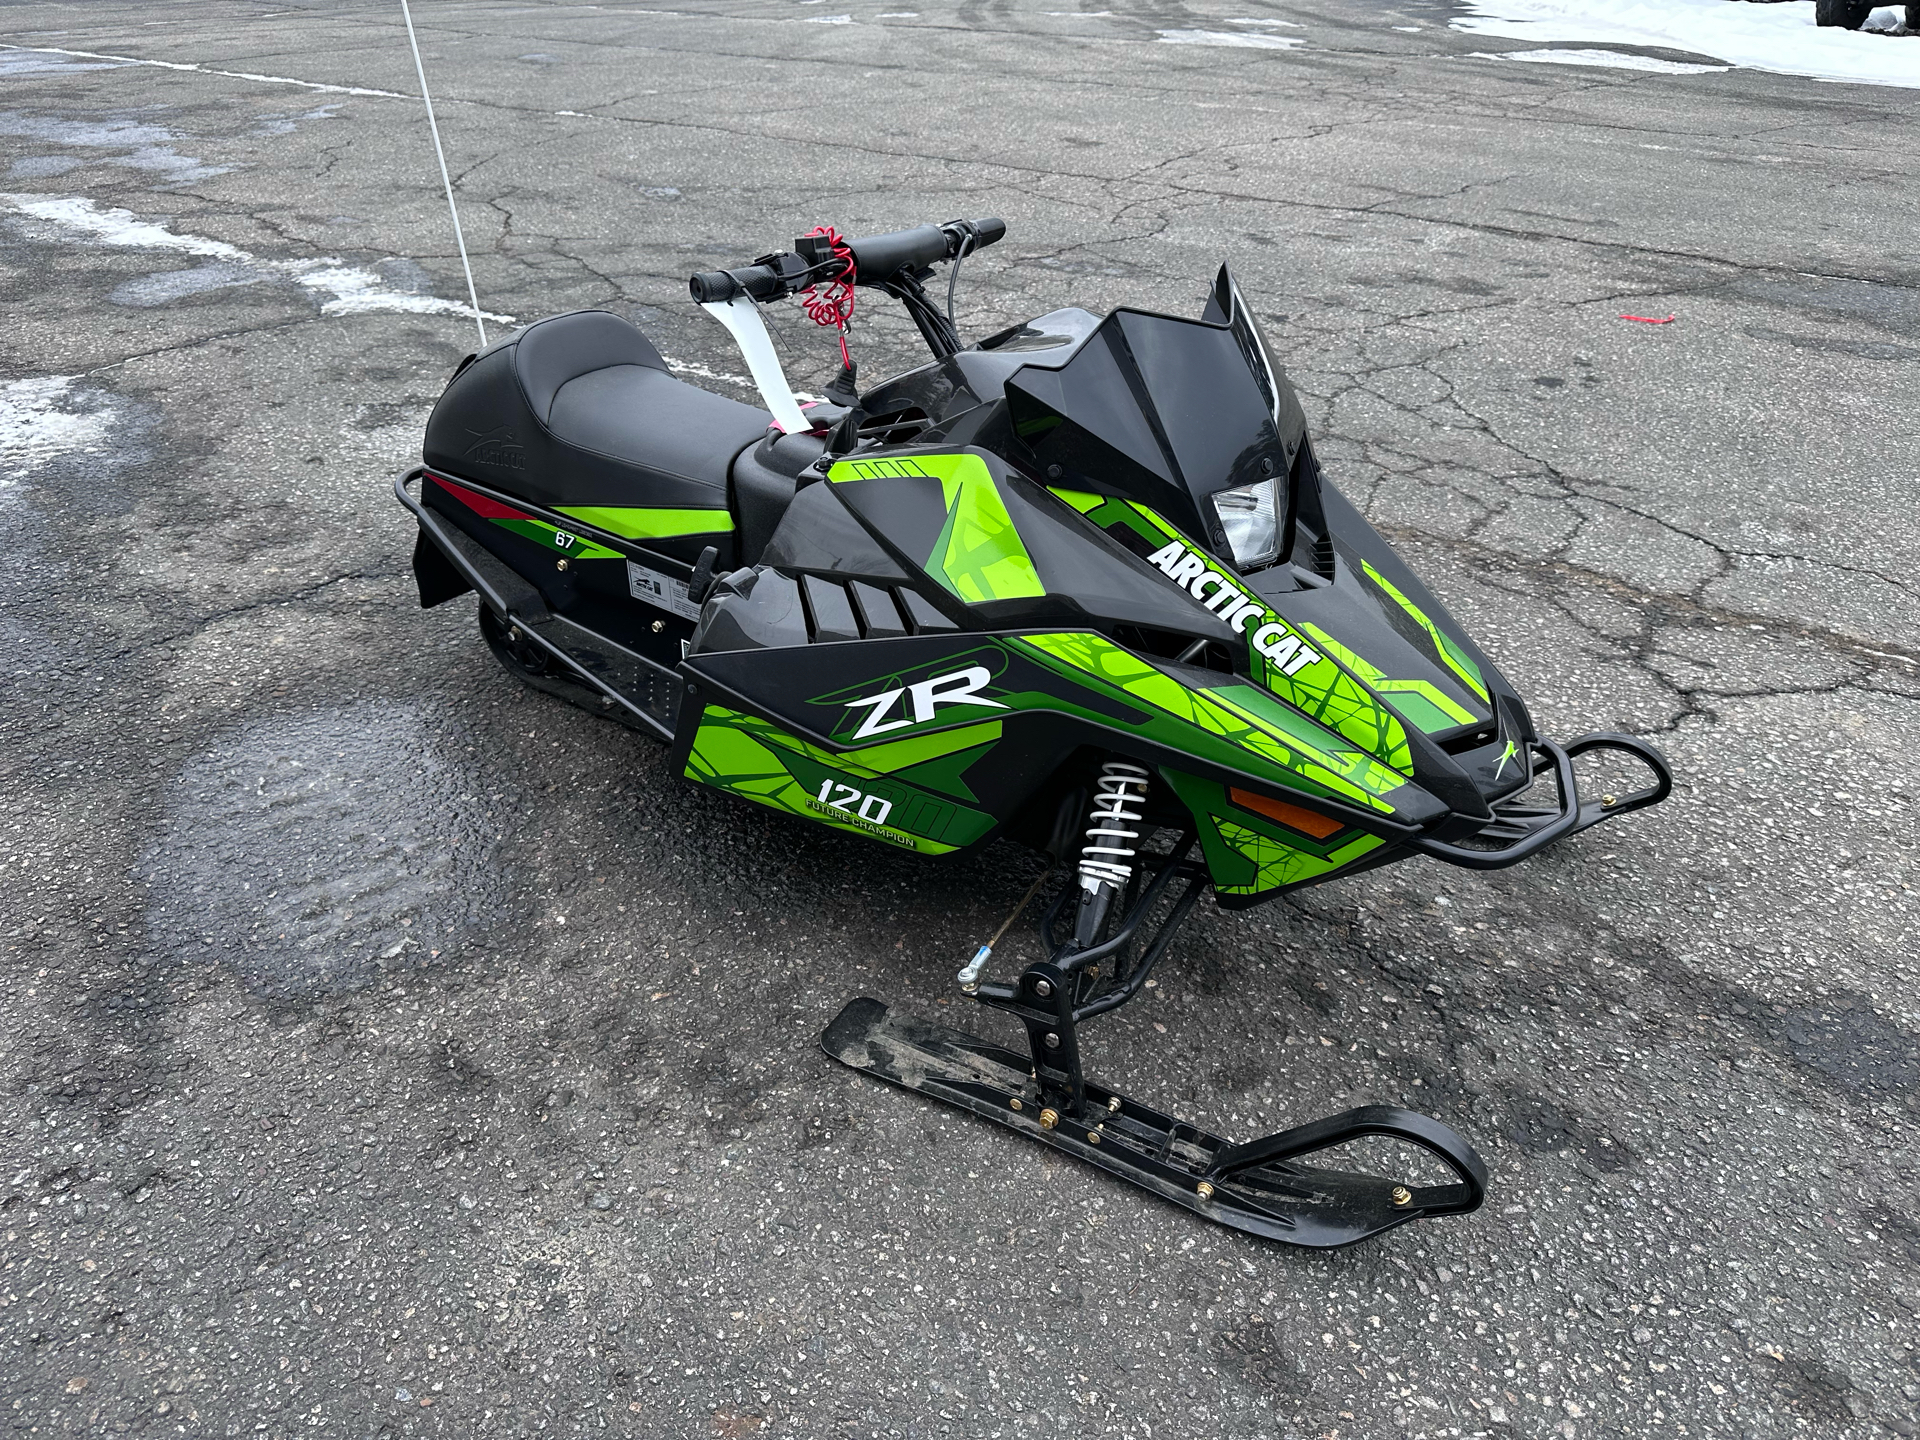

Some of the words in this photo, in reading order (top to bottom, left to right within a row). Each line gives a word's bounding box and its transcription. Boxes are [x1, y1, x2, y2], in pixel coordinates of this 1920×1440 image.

[555, 531, 575, 549] 67
[1147, 539, 1266, 634] ARCTIC
[1252, 621, 1323, 677] CAT
[844, 666, 1012, 740] ZR
[805, 798, 849, 822] FUTURE
[851, 818, 915, 847] CHAMPION
[816, 778, 893, 826] 120
